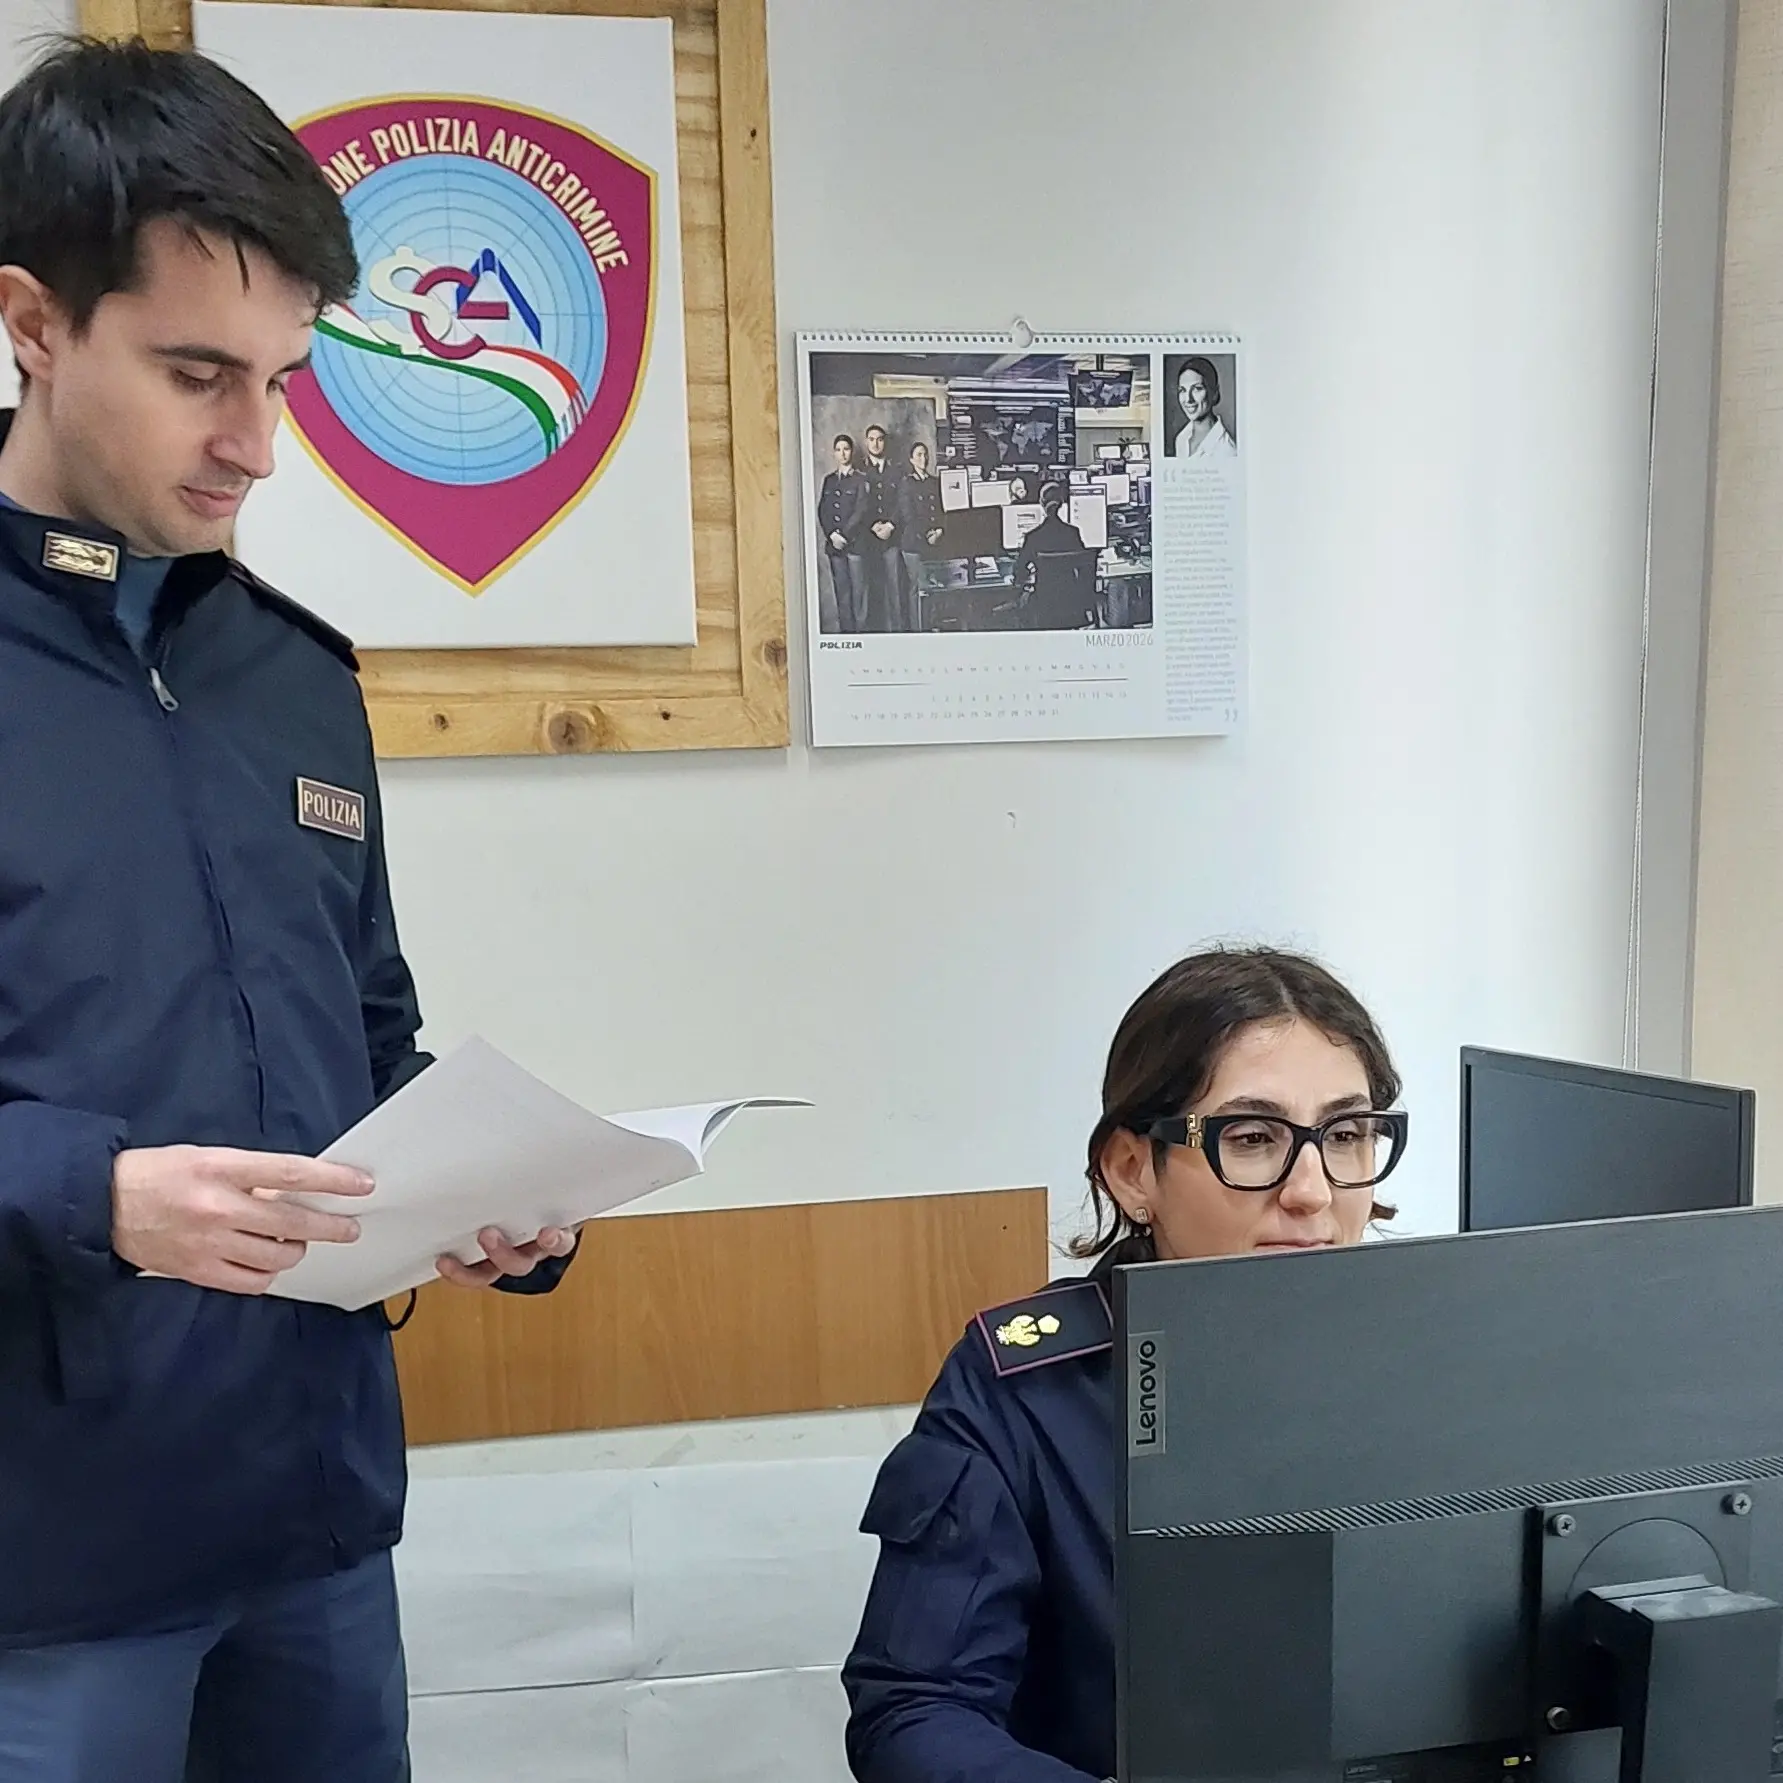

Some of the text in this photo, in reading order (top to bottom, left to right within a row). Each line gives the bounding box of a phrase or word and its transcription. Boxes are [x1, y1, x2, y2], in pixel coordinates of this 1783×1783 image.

[320, 117, 630, 273] ONE POLIZIA ANTICRIMINE
[820, 641, 863, 649] POLIZIA
[1086, 632, 1154, 647] MARZO 2026
[303, 790, 361, 829] POLIZIA
[1135, 1340, 1157, 1446] Lenovo
